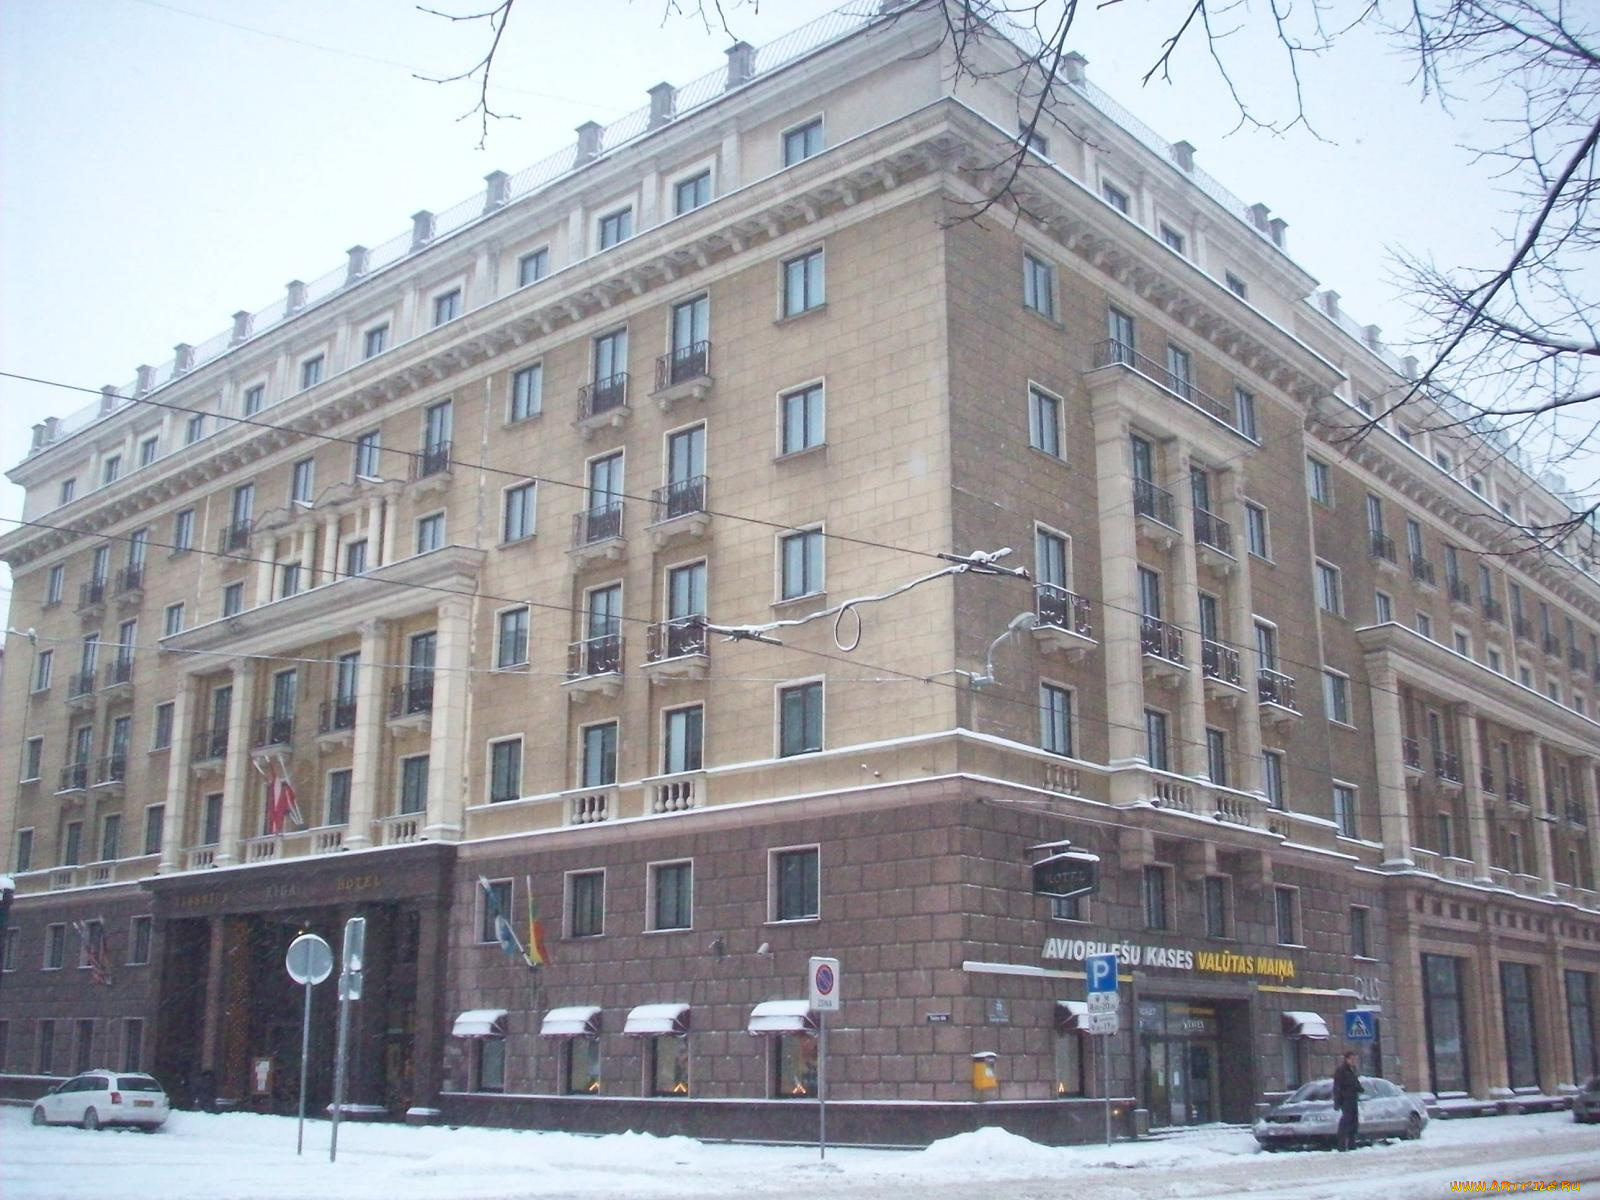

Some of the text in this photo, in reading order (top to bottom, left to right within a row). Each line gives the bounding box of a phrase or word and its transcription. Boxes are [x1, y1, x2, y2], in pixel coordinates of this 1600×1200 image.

[337, 874, 383, 890] HOTEL
[1144, 946, 1194, 970] KASES
[1196, 950, 1255, 974] VALŪTAS
[1093, 960, 1110, 989] P
